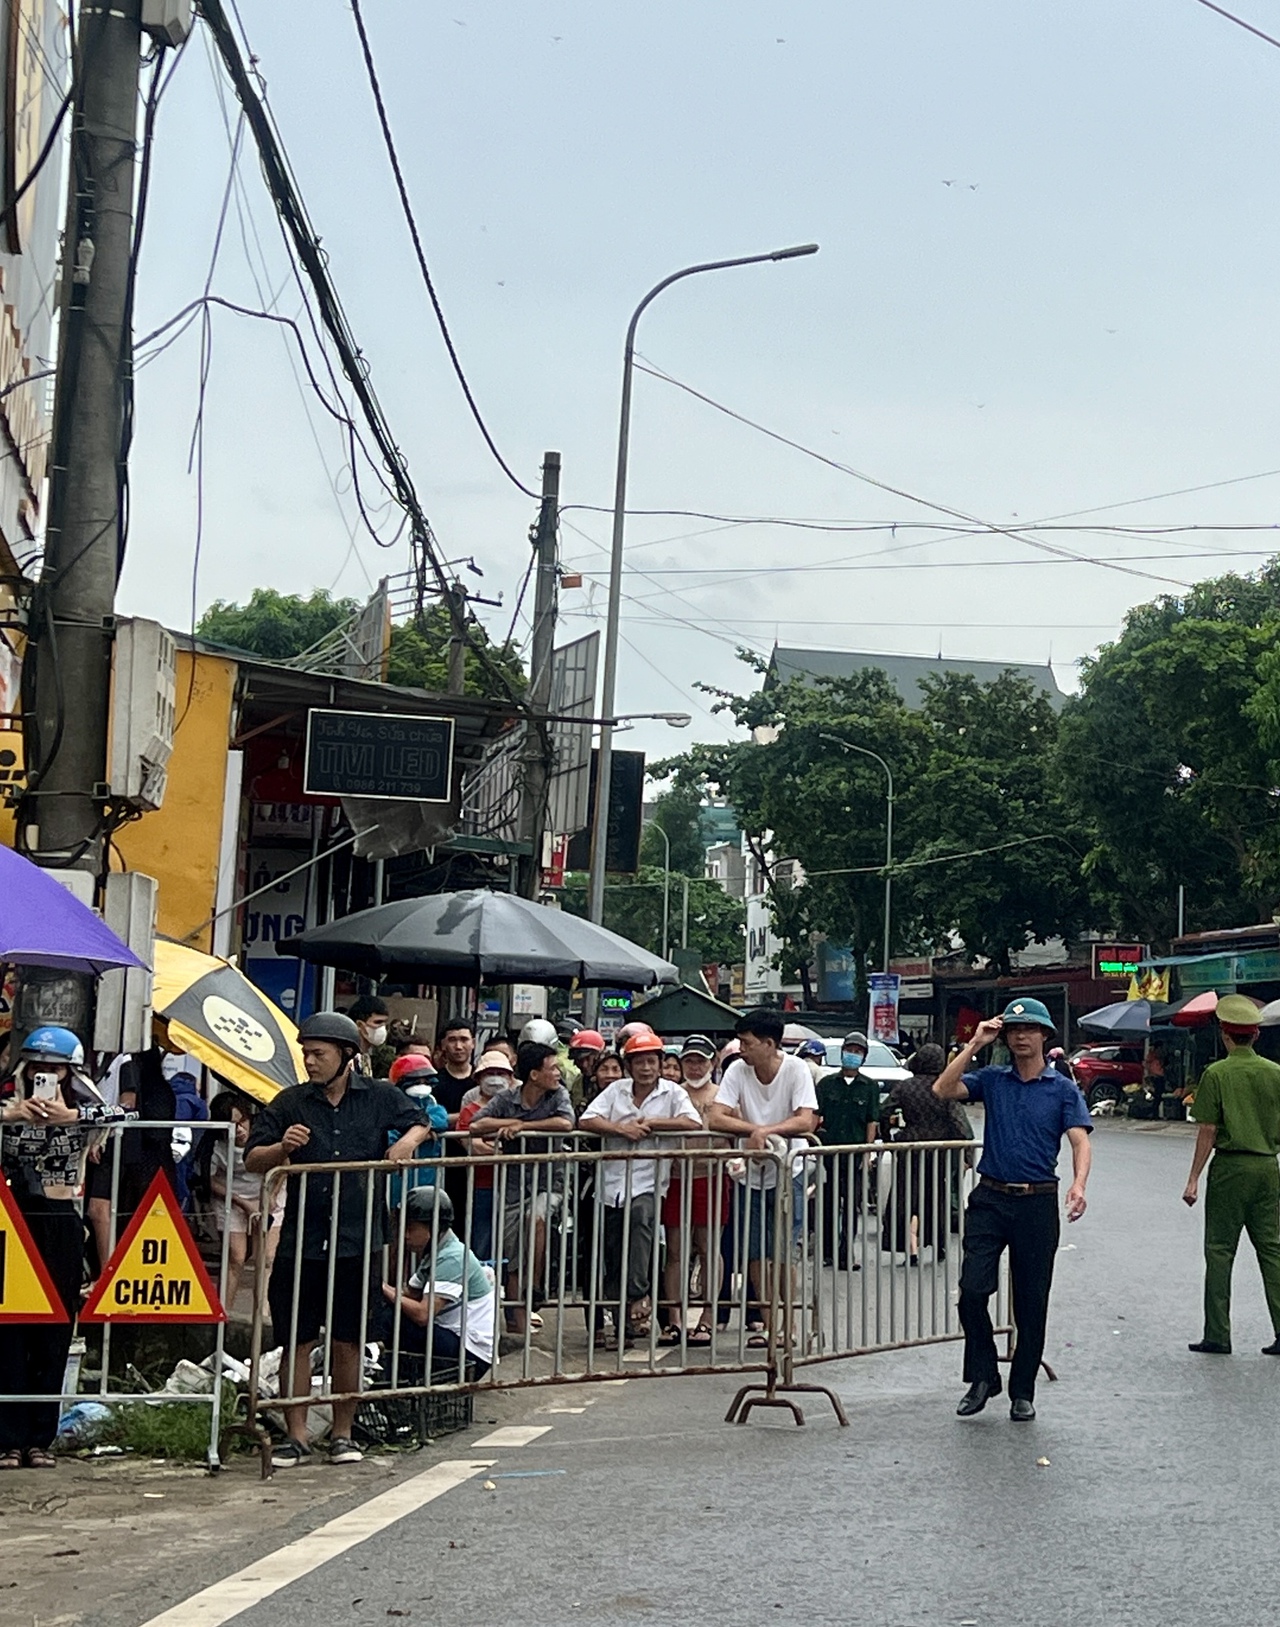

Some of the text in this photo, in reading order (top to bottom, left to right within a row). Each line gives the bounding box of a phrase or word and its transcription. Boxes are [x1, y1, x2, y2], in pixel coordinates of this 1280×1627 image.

[409, 728, 443, 743] chữa
[317, 741, 440, 780] TIVI LED
[378, 780, 396, 792] 211
[400, 781, 421, 793] 739
[141, 1239, 168, 1265] ĐI
[114, 1273, 191, 1311] CHẬM
